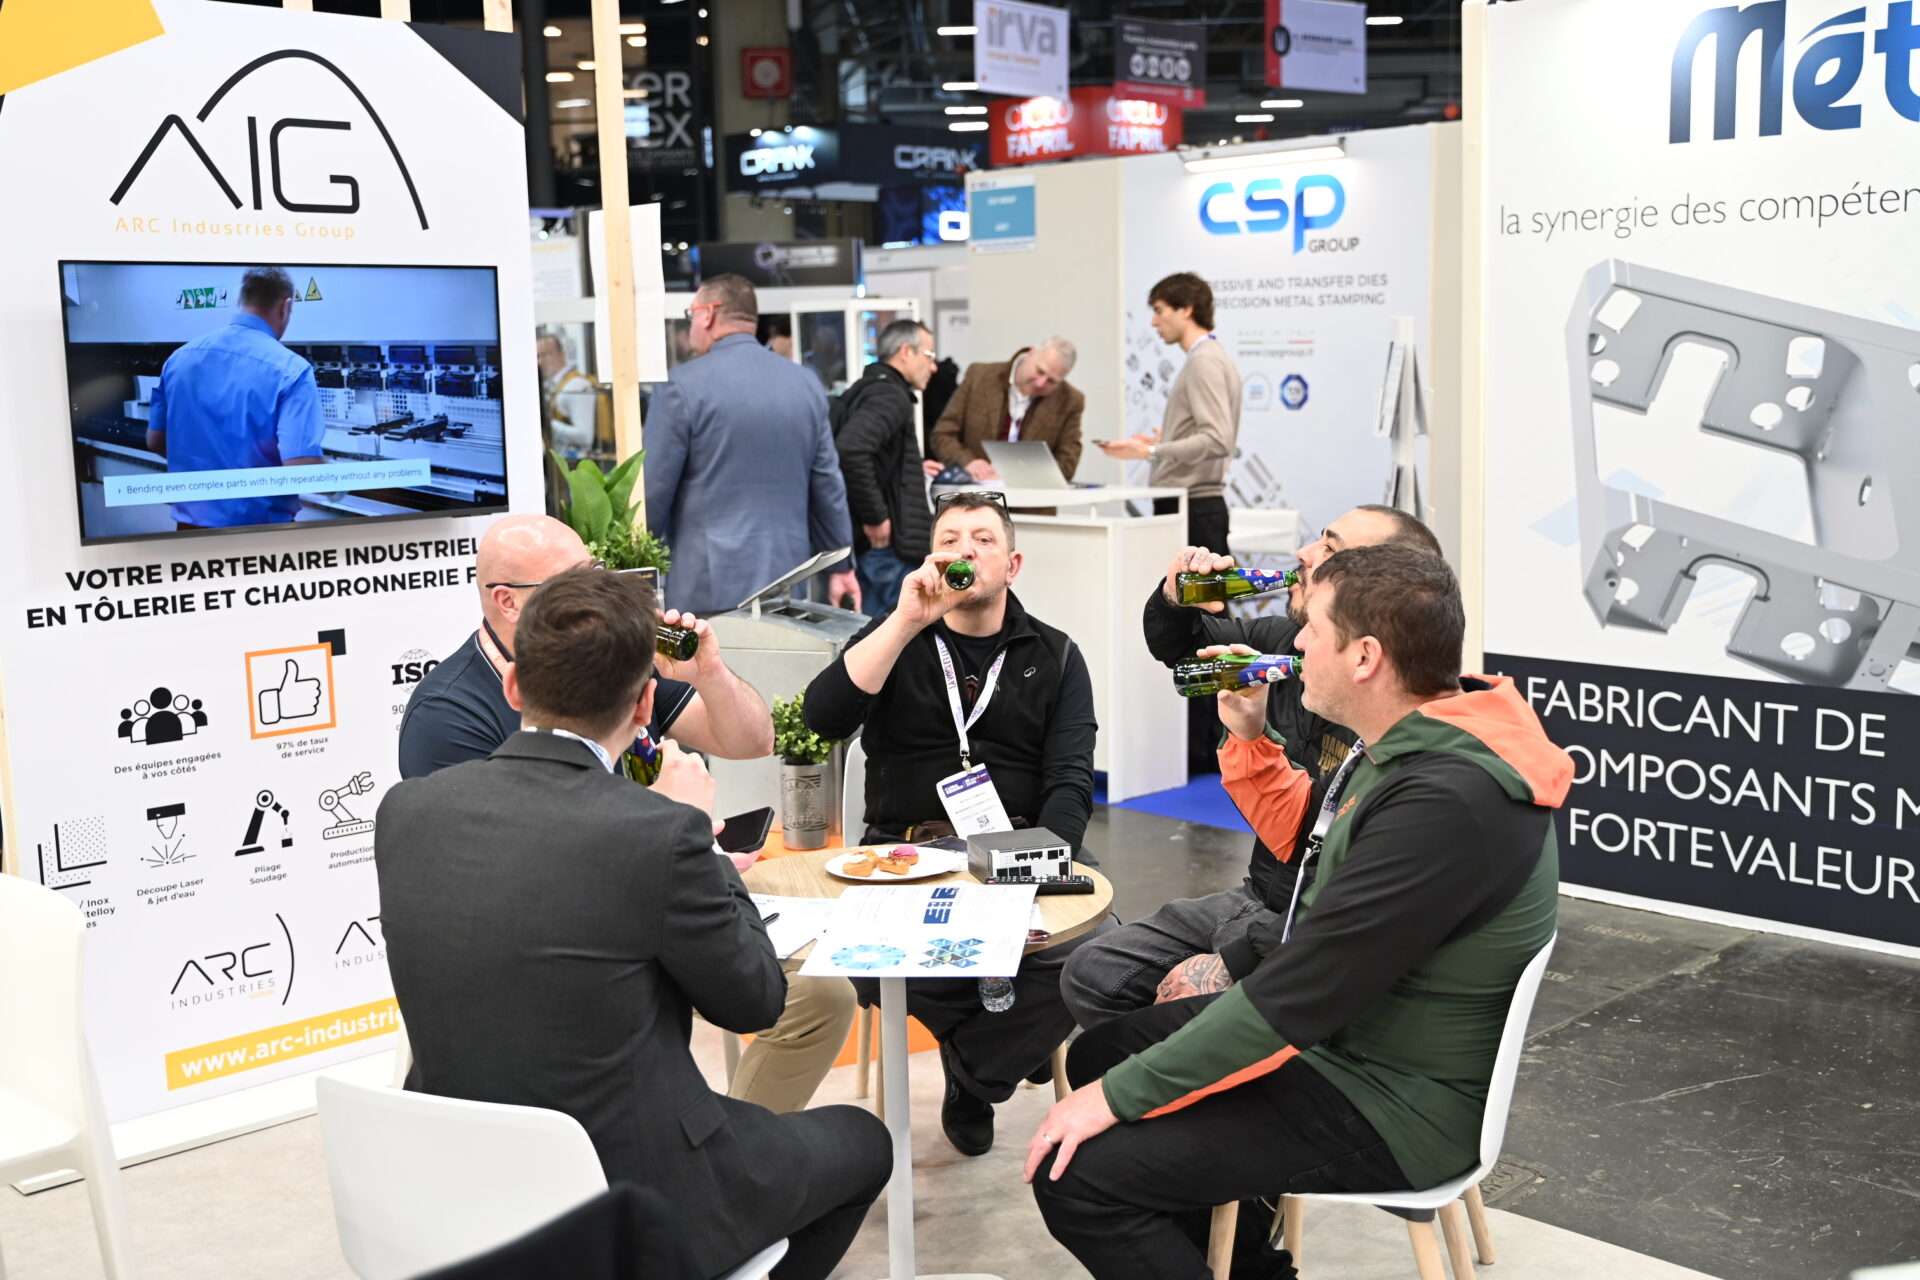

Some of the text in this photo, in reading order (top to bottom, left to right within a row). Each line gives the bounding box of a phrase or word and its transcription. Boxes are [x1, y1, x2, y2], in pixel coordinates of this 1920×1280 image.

[1500, 204, 1521, 235] la
[1531, 196, 1659, 242] synergie
[1671, 193, 1727, 226] des
[115, 216, 356, 241] ARC Industries Group
[1308, 237, 1360, 253] GROUP
[1257, 278, 1284, 290] AND
[1288, 275, 1353, 288] TRANSFER
[1358, 273, 1388, 287] DIES
[1274, 295, 1314, 308] METAL
[1318, 292, 1385, 306] STAMPING
[126, 468, 424, 495] Bending even complex parts with high repeatability without any problems
[66, 563, 163, 591] VOTRE
[170, 549, 338, 582] PARTENAIRE
[27, 605, 66, 629] EN
[75, 593, 196, 624] TÔLERIE
[204, 589, 236, 611] ET
[244, 568, 459, 607] CHAUDRONNERIE
[1526, 675, 1886, 758] FABRICANT DE
[275, 736, 329, 751] 97% de taux
[281, 746, 326, 759] de service
[114, 751, 222, 775] Des équipes engagées
[150, 769, 168, 779] vos
[170, 764, 197, 777] côtés
[254, 863, 281, 874] Pliage
[180, 878, 204, 889] Laser
[249, 872, 287, 885] Soudage
[87, 897, 110, 908] Inox
[156, 895, 168, 905] jet
[170, 890, 196, 901] d'eau
[84, 907, 116, 918] telloy
[170, 977, 277, 1011] INDUSTRIES
